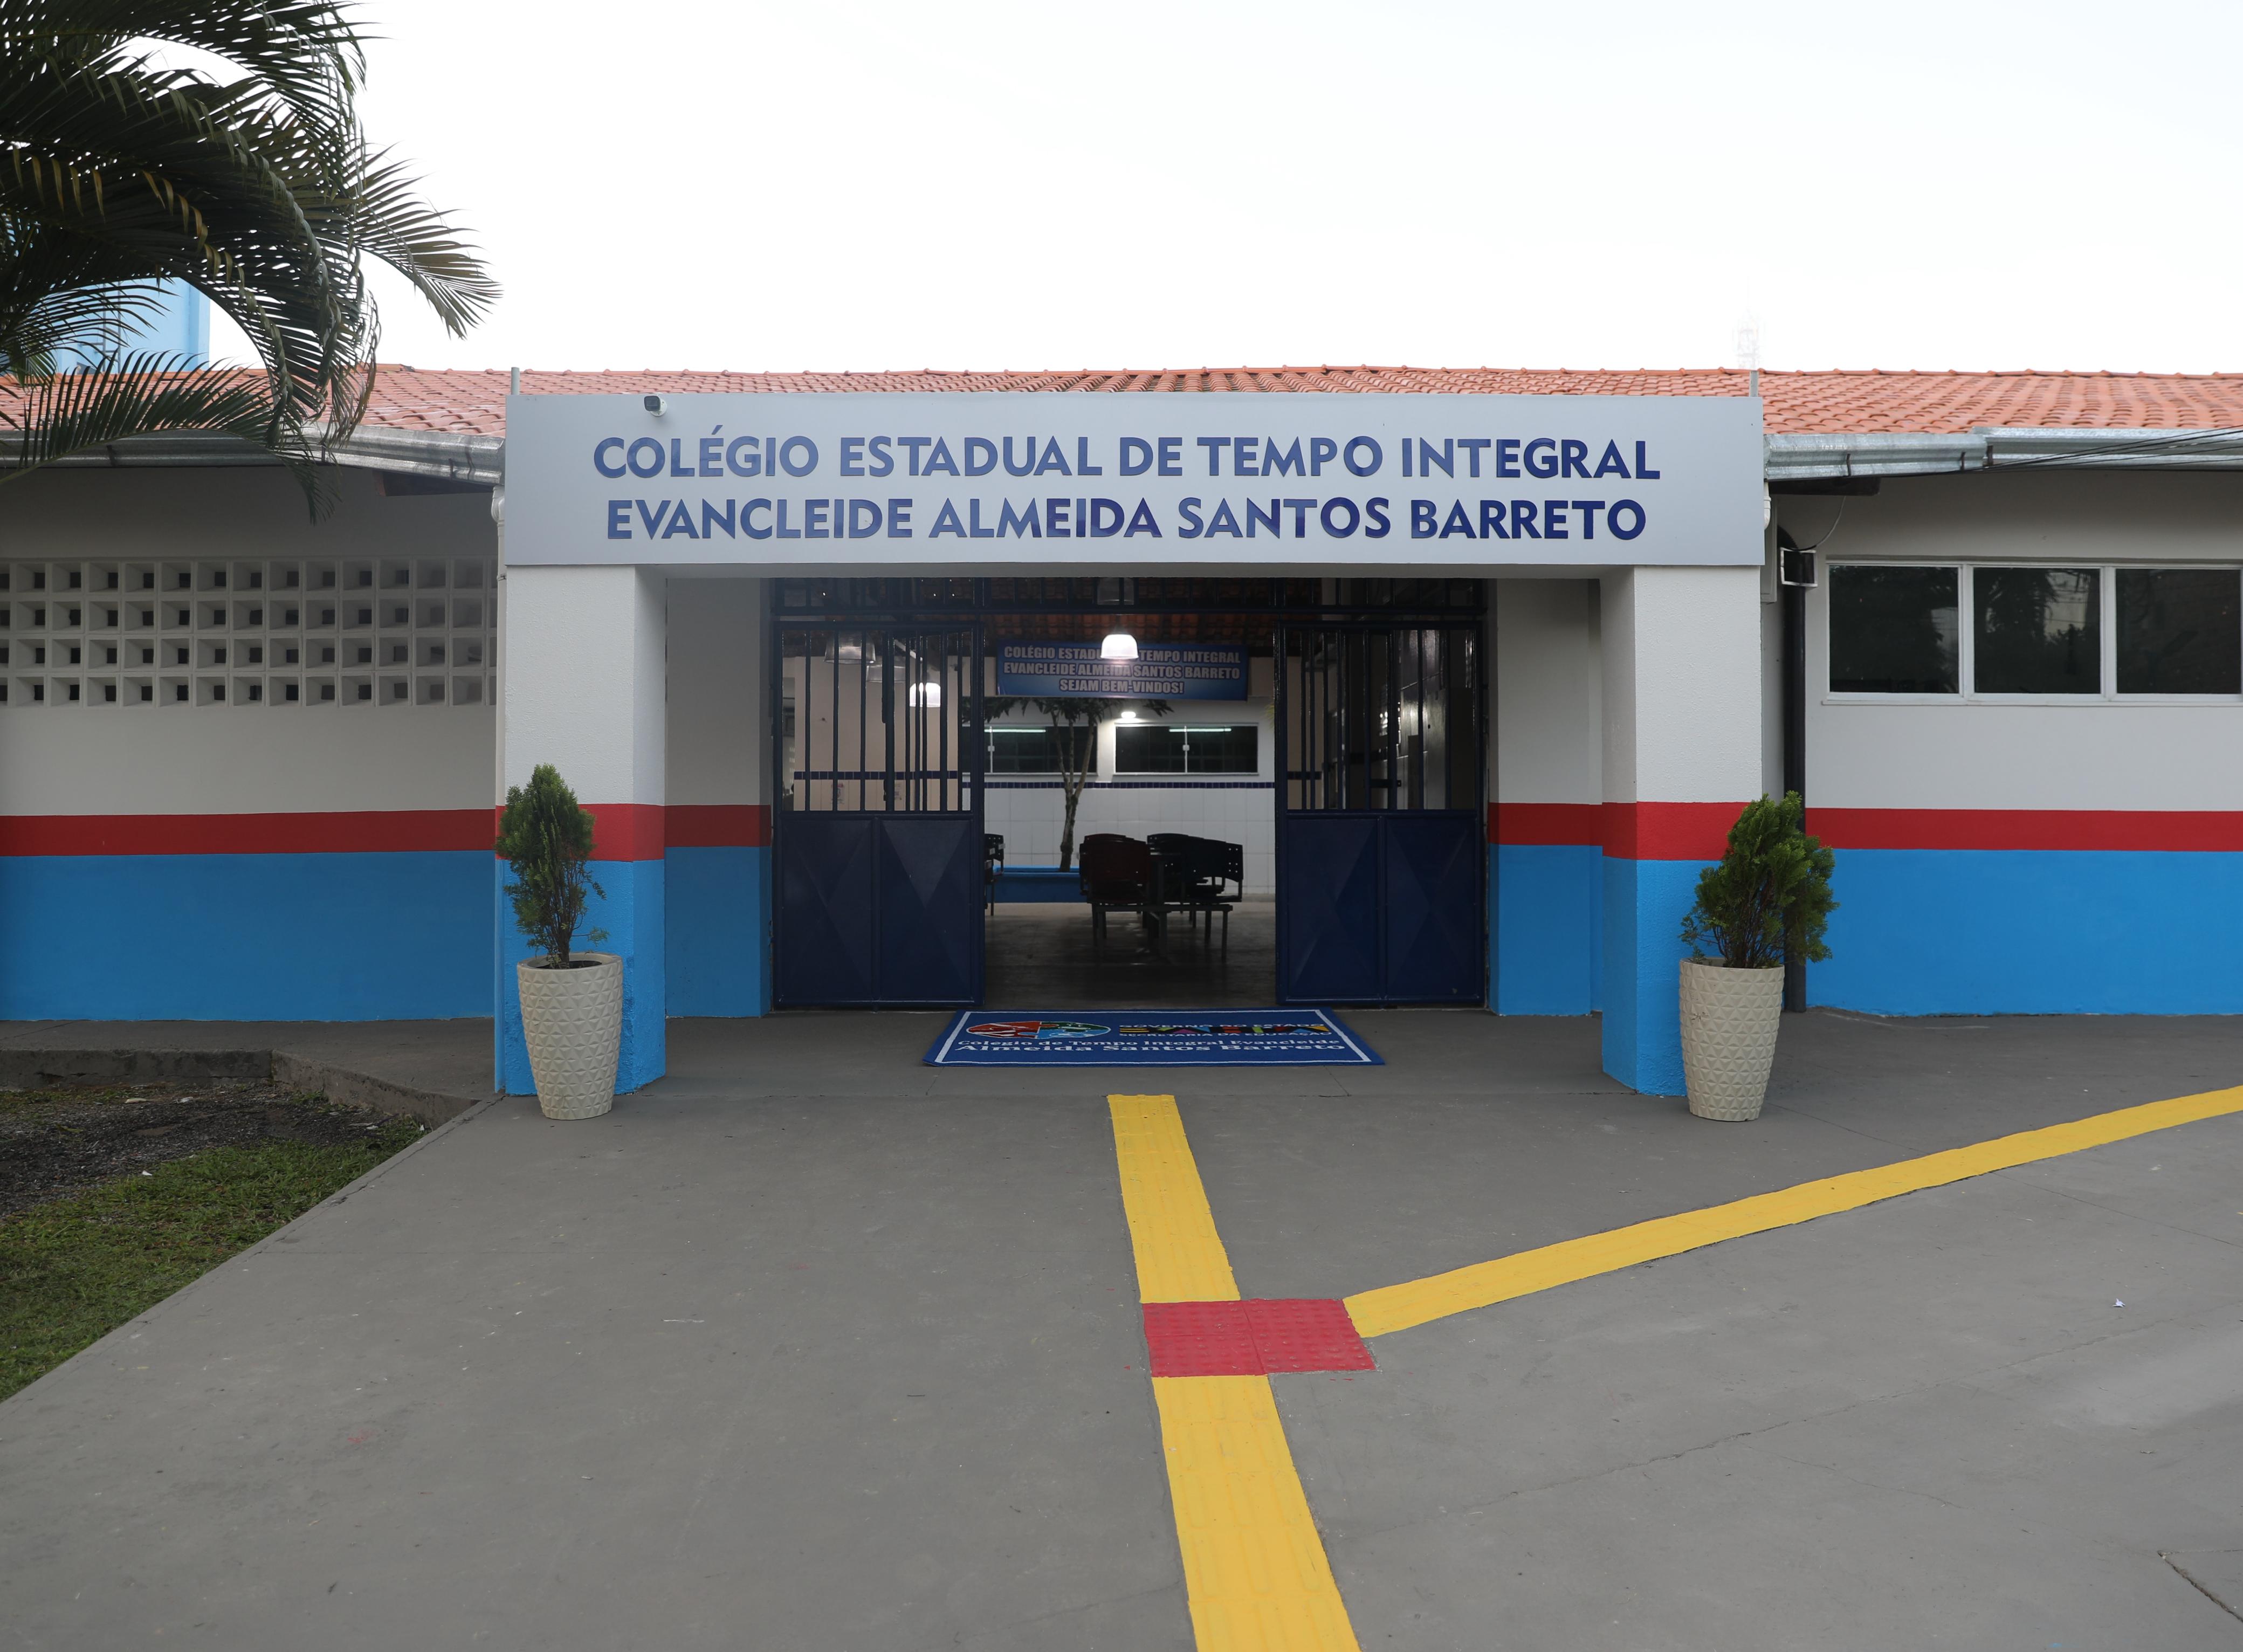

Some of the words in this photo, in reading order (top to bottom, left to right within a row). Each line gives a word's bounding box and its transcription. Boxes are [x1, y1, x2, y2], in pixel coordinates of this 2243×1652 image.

[594, 425, 818, 478] COLÉGIO
[841, 436, 1103, 477] ESTADUAL
[1120, 437, 1183, 476] DE
[1198, 436, 1383, 477] TEMPO
[1402, 437, 1661, 479] INTEGRAL
[608, 498, 913, 539] EVANCLEIDE
[930, 498, 1162, 538] ALMEIDA
[1178, 497, 1391, 538] SANTOS
[1411, 499, 1646, 540] BARRETO
[1004, 646, 1056, 659] COLÉGIO
[1058, 649, 1103, 660] ESTADU
[1140, 650, 1180, 662] TEMPO
[1183, 651, 1241, 663] INTEGRAL
[1003, 663, 1076, 676] EVANCLEIDE
[1078, 664, 1131, 677] ALMEIDA
[1133, 665, 1182, 678] SANTOS
[1185, 667, 1241, 679] BARRETO
[1059, 679, 1099, 692] SEJAM
[1102, 681, 1184, 694] BEM-VINDOS!
